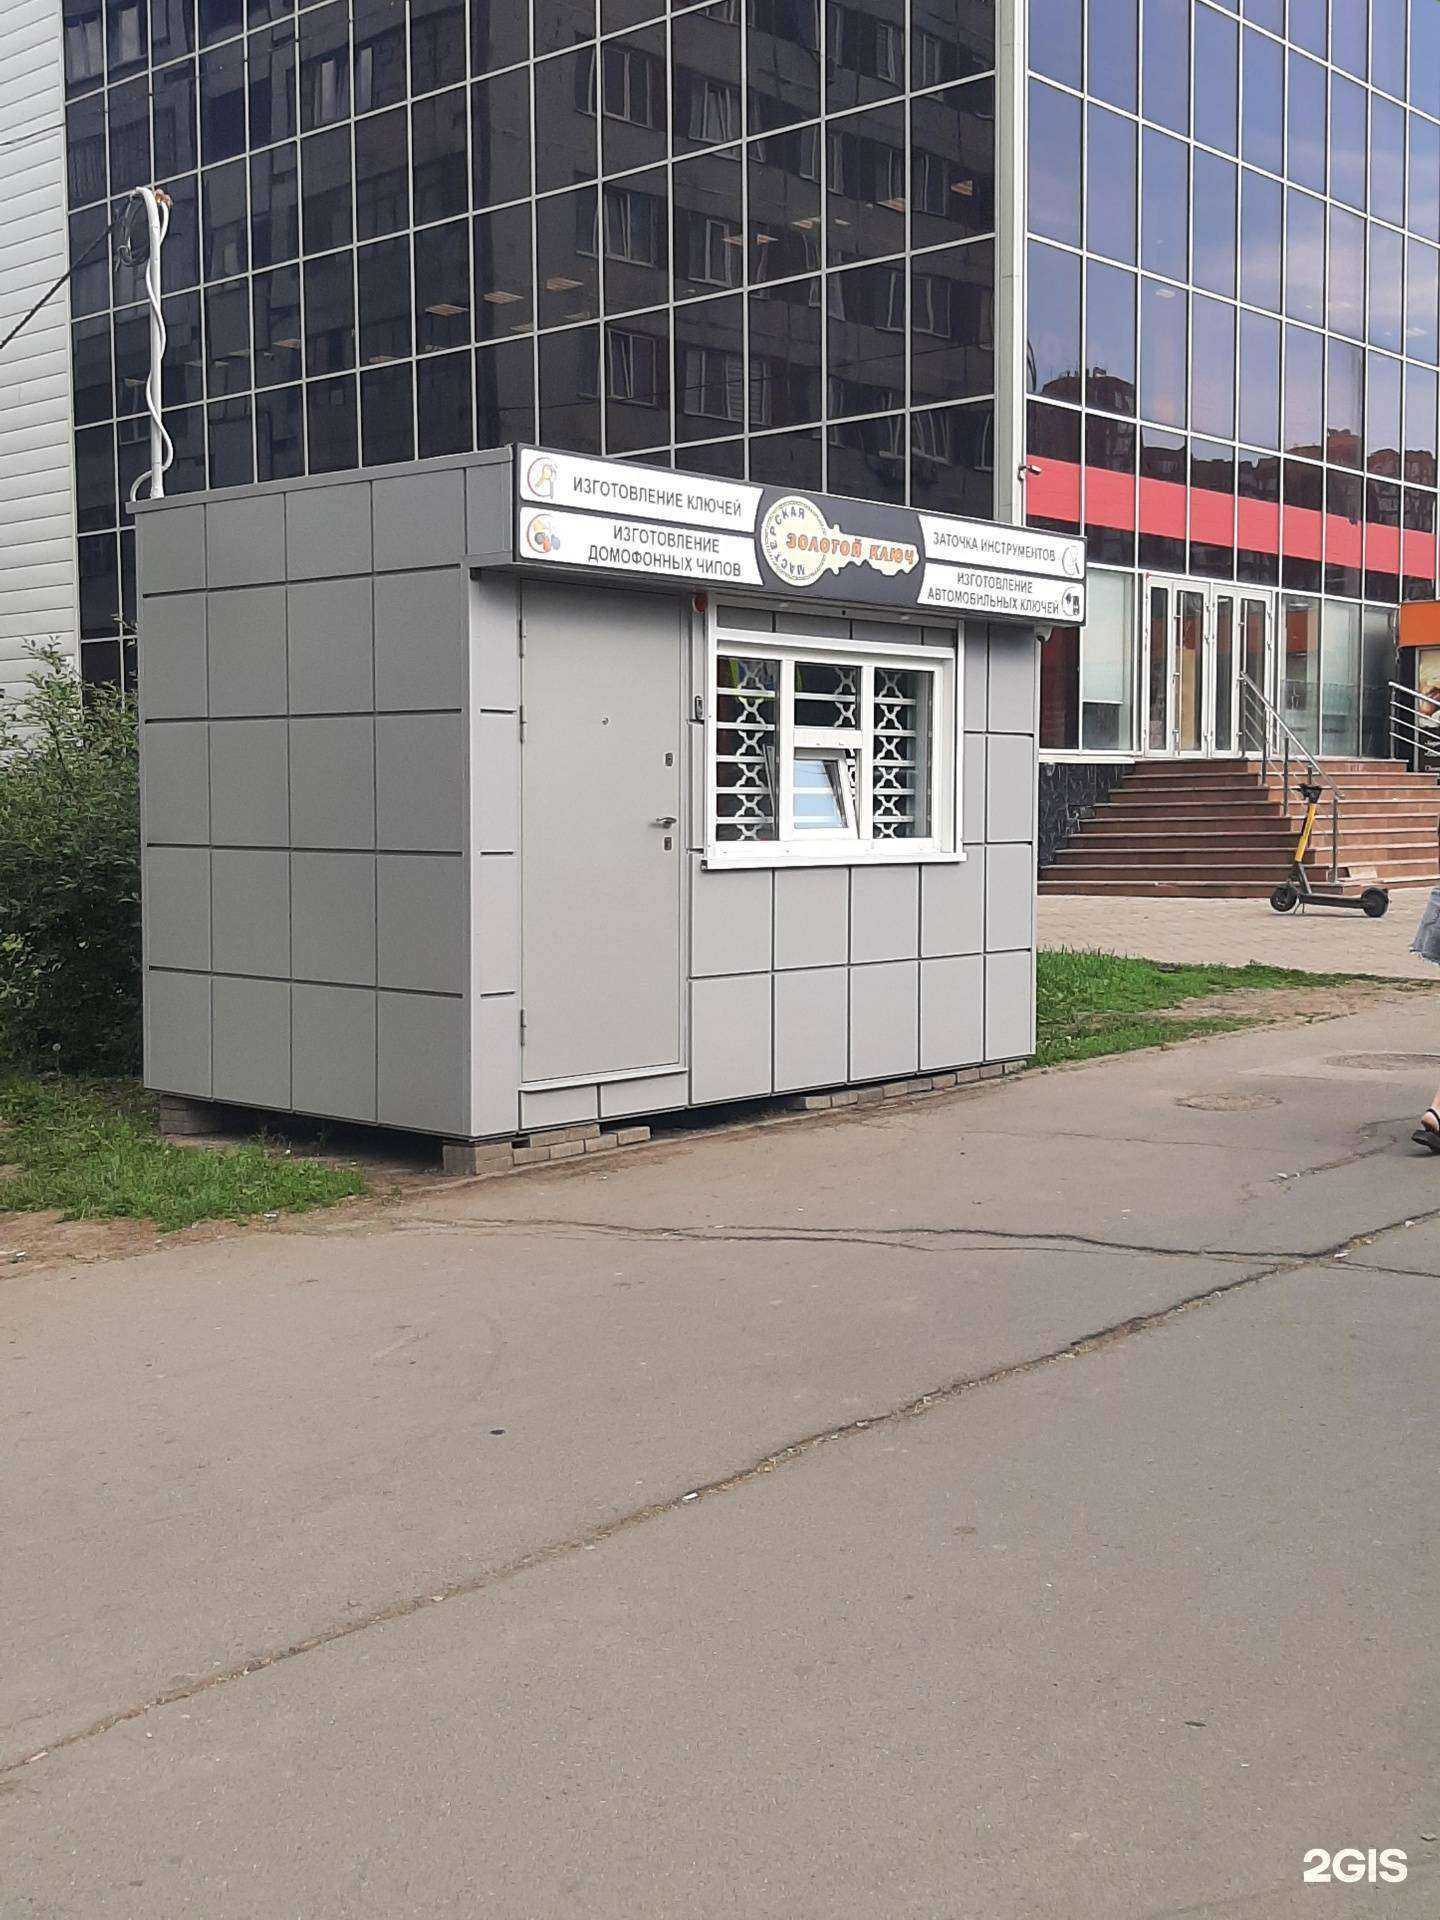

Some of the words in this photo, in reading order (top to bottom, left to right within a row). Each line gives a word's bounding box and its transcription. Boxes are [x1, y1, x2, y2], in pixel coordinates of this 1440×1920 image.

[573, 476, 683, 508] ИЗГОТОВЛЕНИЕ
[687, 494, 742, 517] КЛЮЧЕЙ
[613, 525, 720, 554] ИЗГОТОВЛЕНИЕ
[786, 532, 862, 558] ЗОЛОТОЙ
[869, 544, 914, 566] КЛЮЧ
[933, 531, 978, 552] ЗАТОЧКА
[981, 538, 1056, 563] ИНСТРУМЕНТОВ
[588, 544, 693, 571] ДОМОФОННЫХ
[696, 559, 742, 577] ЧИПОВ
[957, 572, 1033, 594] ИЗГОТОВЛЕНИЕ
[927, 586, 1018, 610] АВТОМОБИЛЬНЫХ
[1020, 599, 1059, 615] КЛЮЧЕЙ
